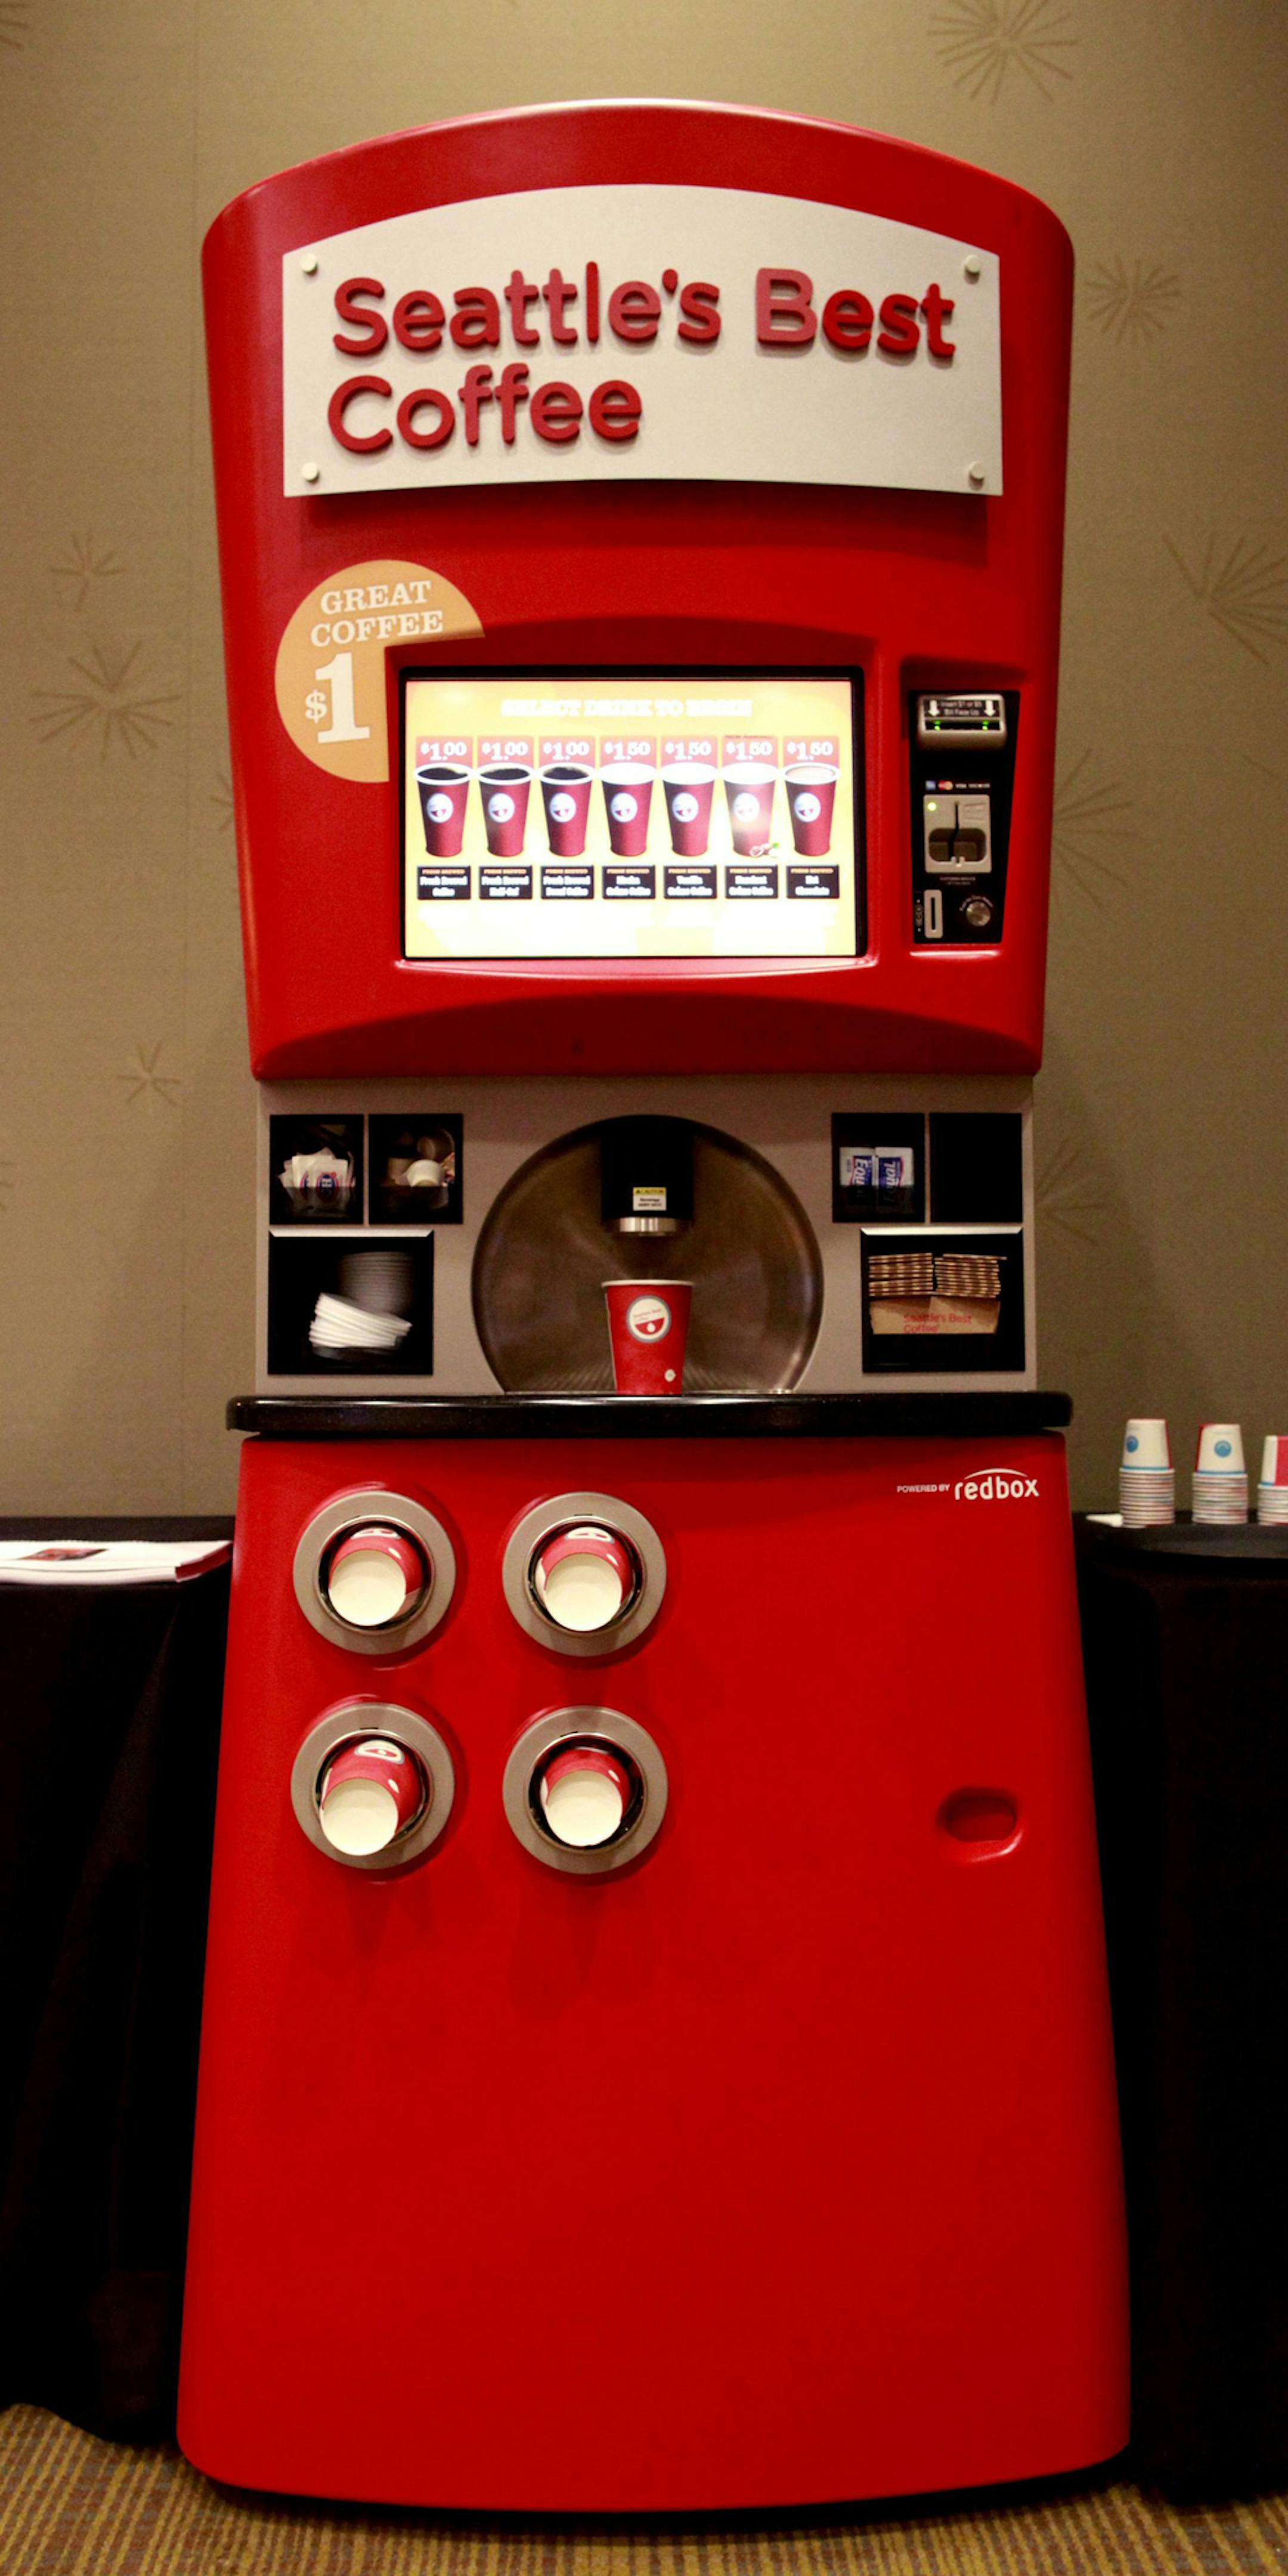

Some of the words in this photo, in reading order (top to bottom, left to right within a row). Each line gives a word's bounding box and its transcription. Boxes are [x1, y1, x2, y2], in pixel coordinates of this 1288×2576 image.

[333, 261, 722, 356] Seattle's
[756, 268, 955, 357] Best
[328, 363, 642, 453] Coffee
[320, 581, 431, 615] GREAT
[311, 611, 443, 647] COFFEE
[305, 652, 370, 744] $1
[420, 742, 467, 761] $1.00
[482, 742, 528, 761] $1.00
[543, 742, 590, 761] $1.00
[604, 742, 651, 761] $1.50
[665, 742, 711, 761] $1.50
[726, 742, 773, 761] $1.50
[787, 742, 834, 761] $1.50
[949, 1313, 972, 1324] Best
[897, 1484, 937, 1493] POWERED
[955, 1475, 1039, 1500] redbox
